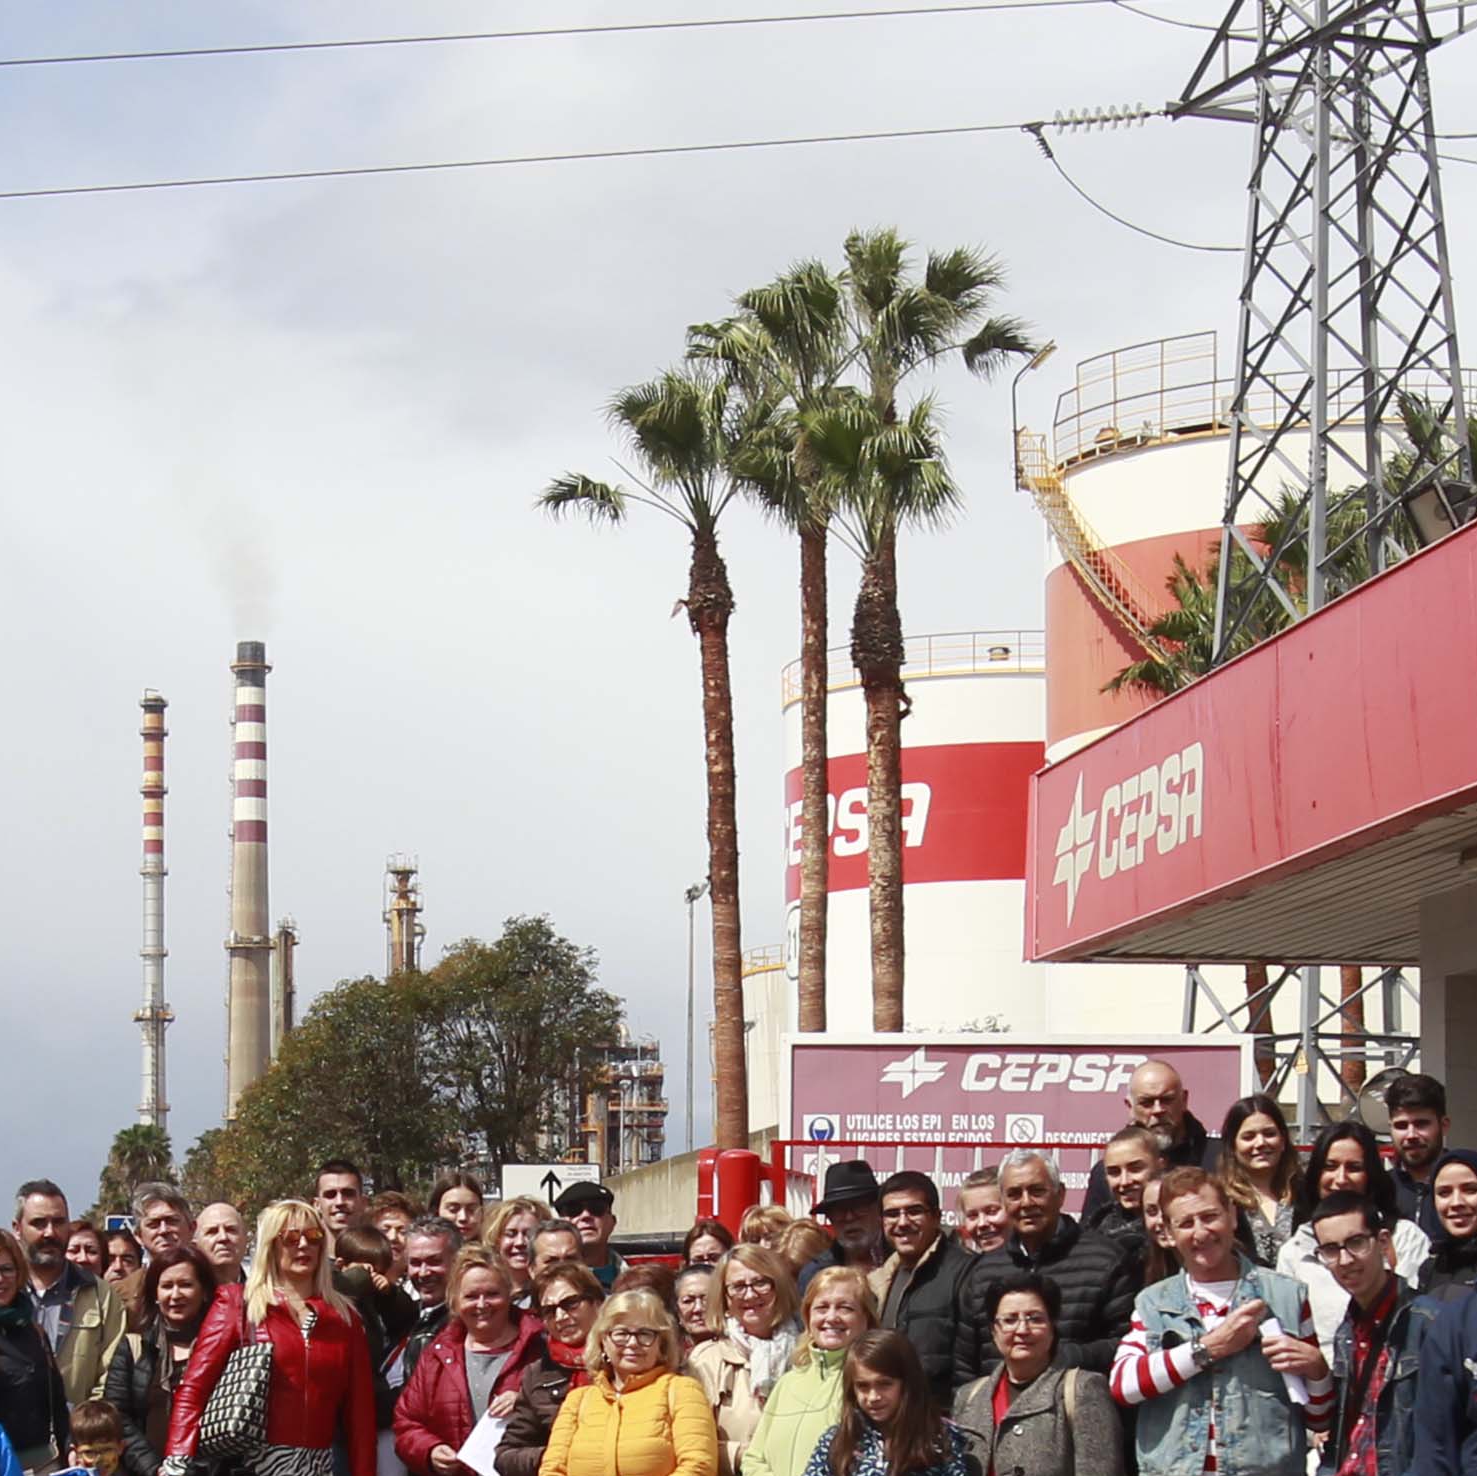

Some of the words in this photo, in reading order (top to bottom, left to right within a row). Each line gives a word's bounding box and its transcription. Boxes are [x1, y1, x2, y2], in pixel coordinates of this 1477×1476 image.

[786, 782, 932, 867] ESA
[1098, 741, 1205, 880] CEPSA
[846, 1114, 893, 1130] UTILICE
[895, 1114, 920, 1130] LOS
[922, 1114, 942, 1130] EPI
[951, 1114, 969, 1130] EN
[971, 1114, 995, 1130] LOS
